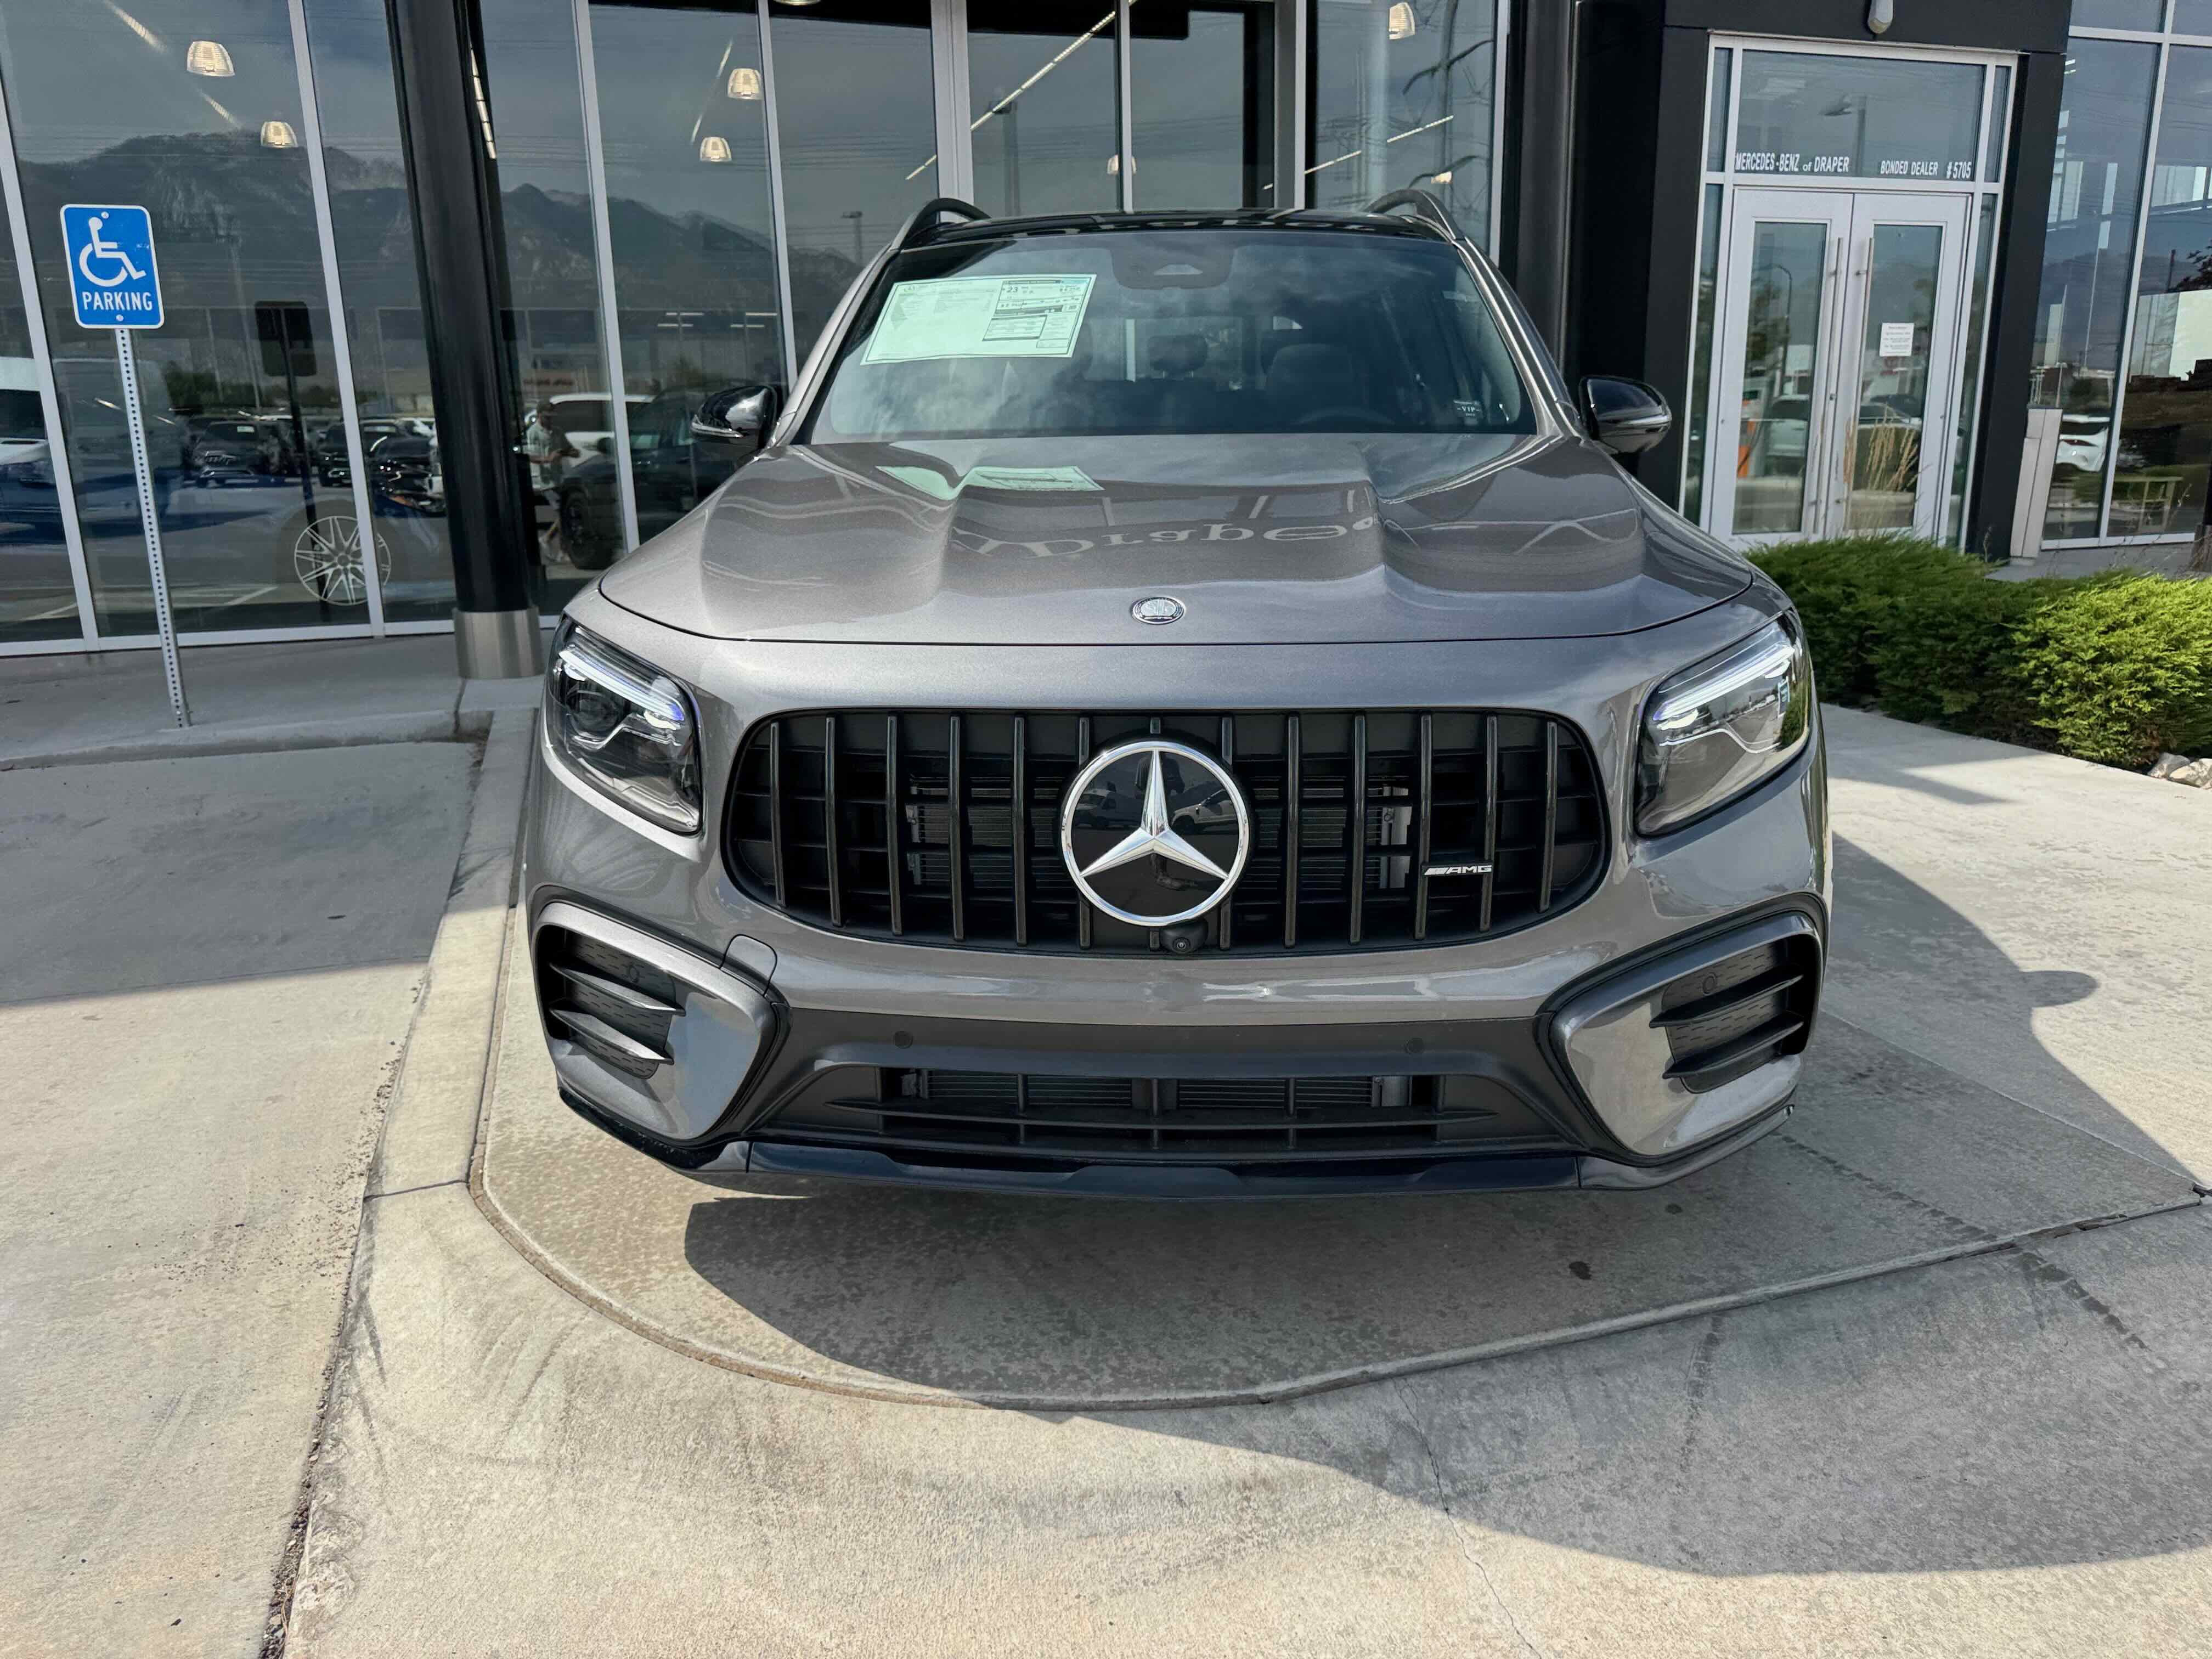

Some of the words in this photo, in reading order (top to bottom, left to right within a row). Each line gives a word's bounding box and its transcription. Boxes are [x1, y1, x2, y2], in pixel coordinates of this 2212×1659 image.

[1735, 152, 1800, 172] MERCEDES-BENZ
[1802, 161, 1813, 172] of
[1813, 156, 1849, 172] DRAPER
[1880, 160, 1909, 174] BONDED
[1911, 161, 1939, 176] DEALER
[82, 291, 153, 311] PARKING
[1446, 865, 1492, 874] AMG
